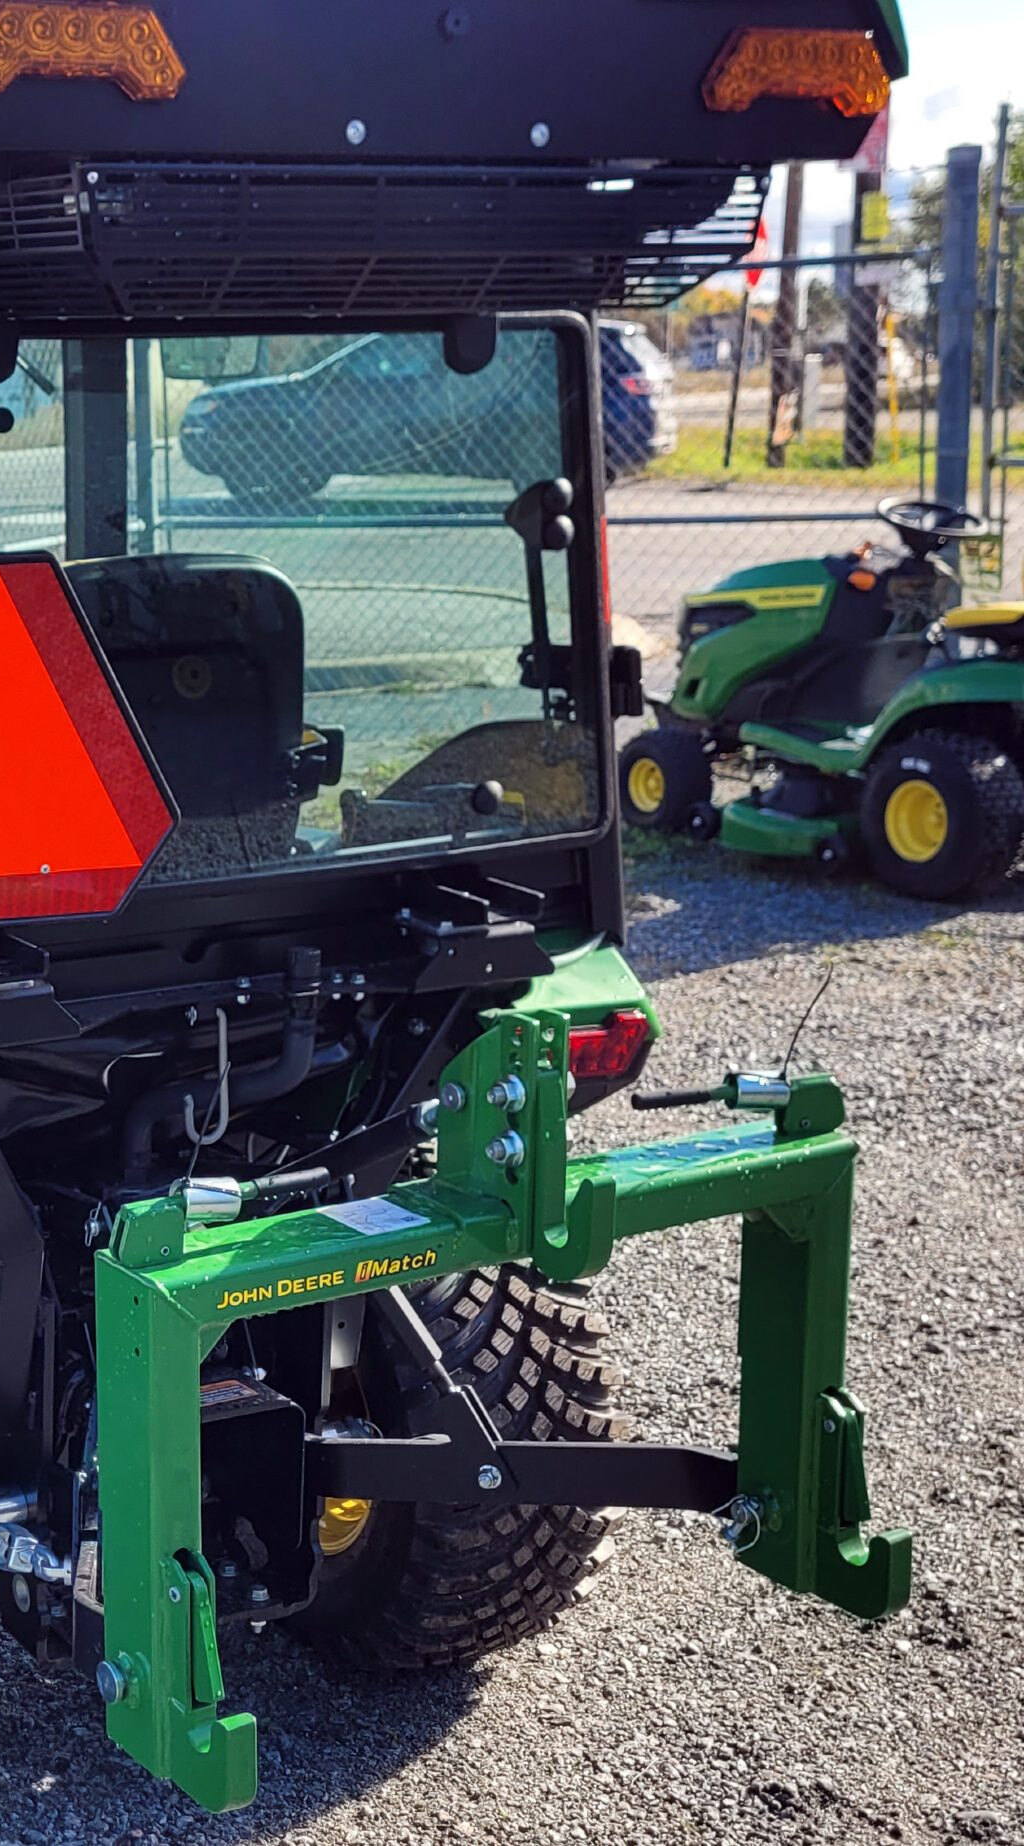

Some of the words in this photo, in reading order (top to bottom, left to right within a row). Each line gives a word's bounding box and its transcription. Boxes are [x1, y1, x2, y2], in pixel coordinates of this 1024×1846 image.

[217, 1284, 272, 1309] JOHN
[277, 1269, 344, 1297] DEERE
[354, 1249, 437, 1283] iMatch
